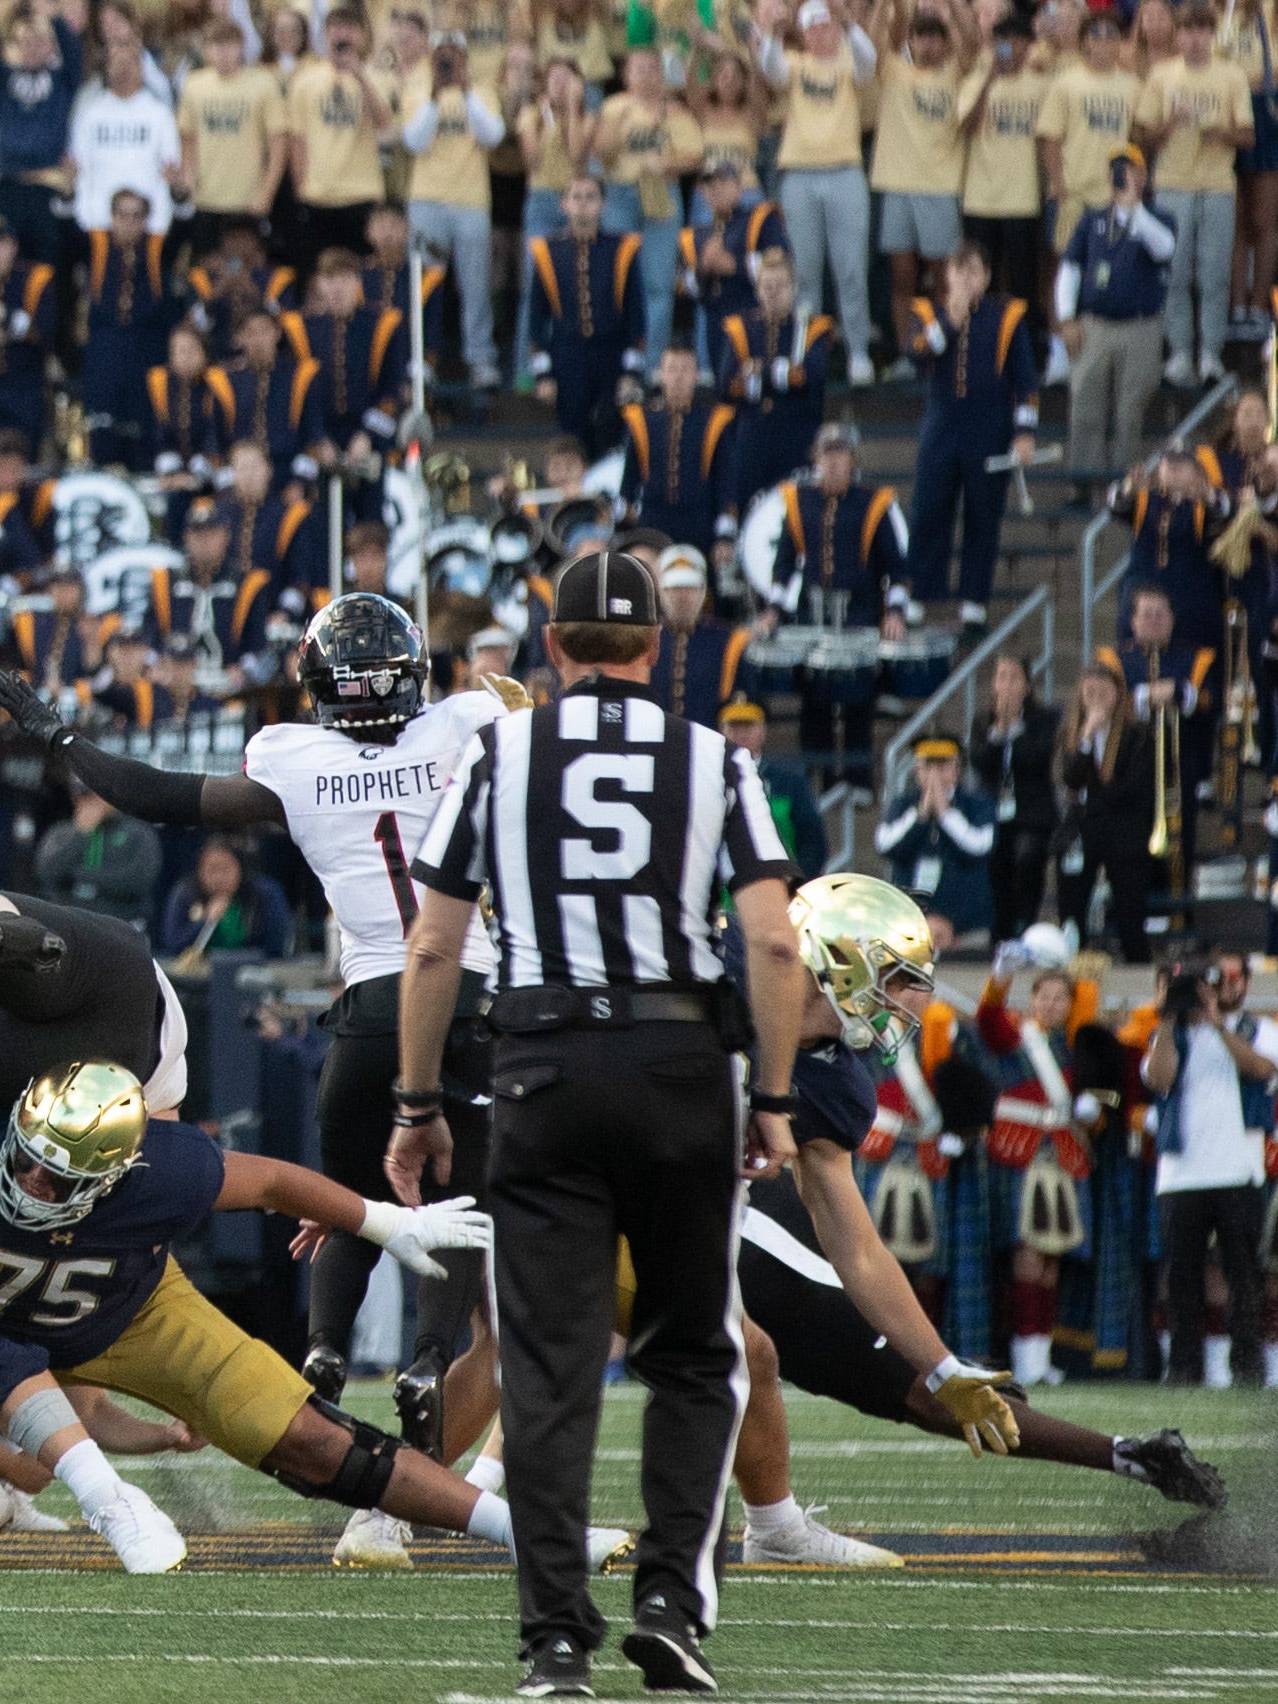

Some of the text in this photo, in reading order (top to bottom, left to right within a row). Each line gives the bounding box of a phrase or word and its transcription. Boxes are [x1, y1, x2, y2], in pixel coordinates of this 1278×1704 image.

[316, 761, 442, 807] PROPHETE
[559, 752, 656, 880] S
[373, 811, 421, 940] 1
